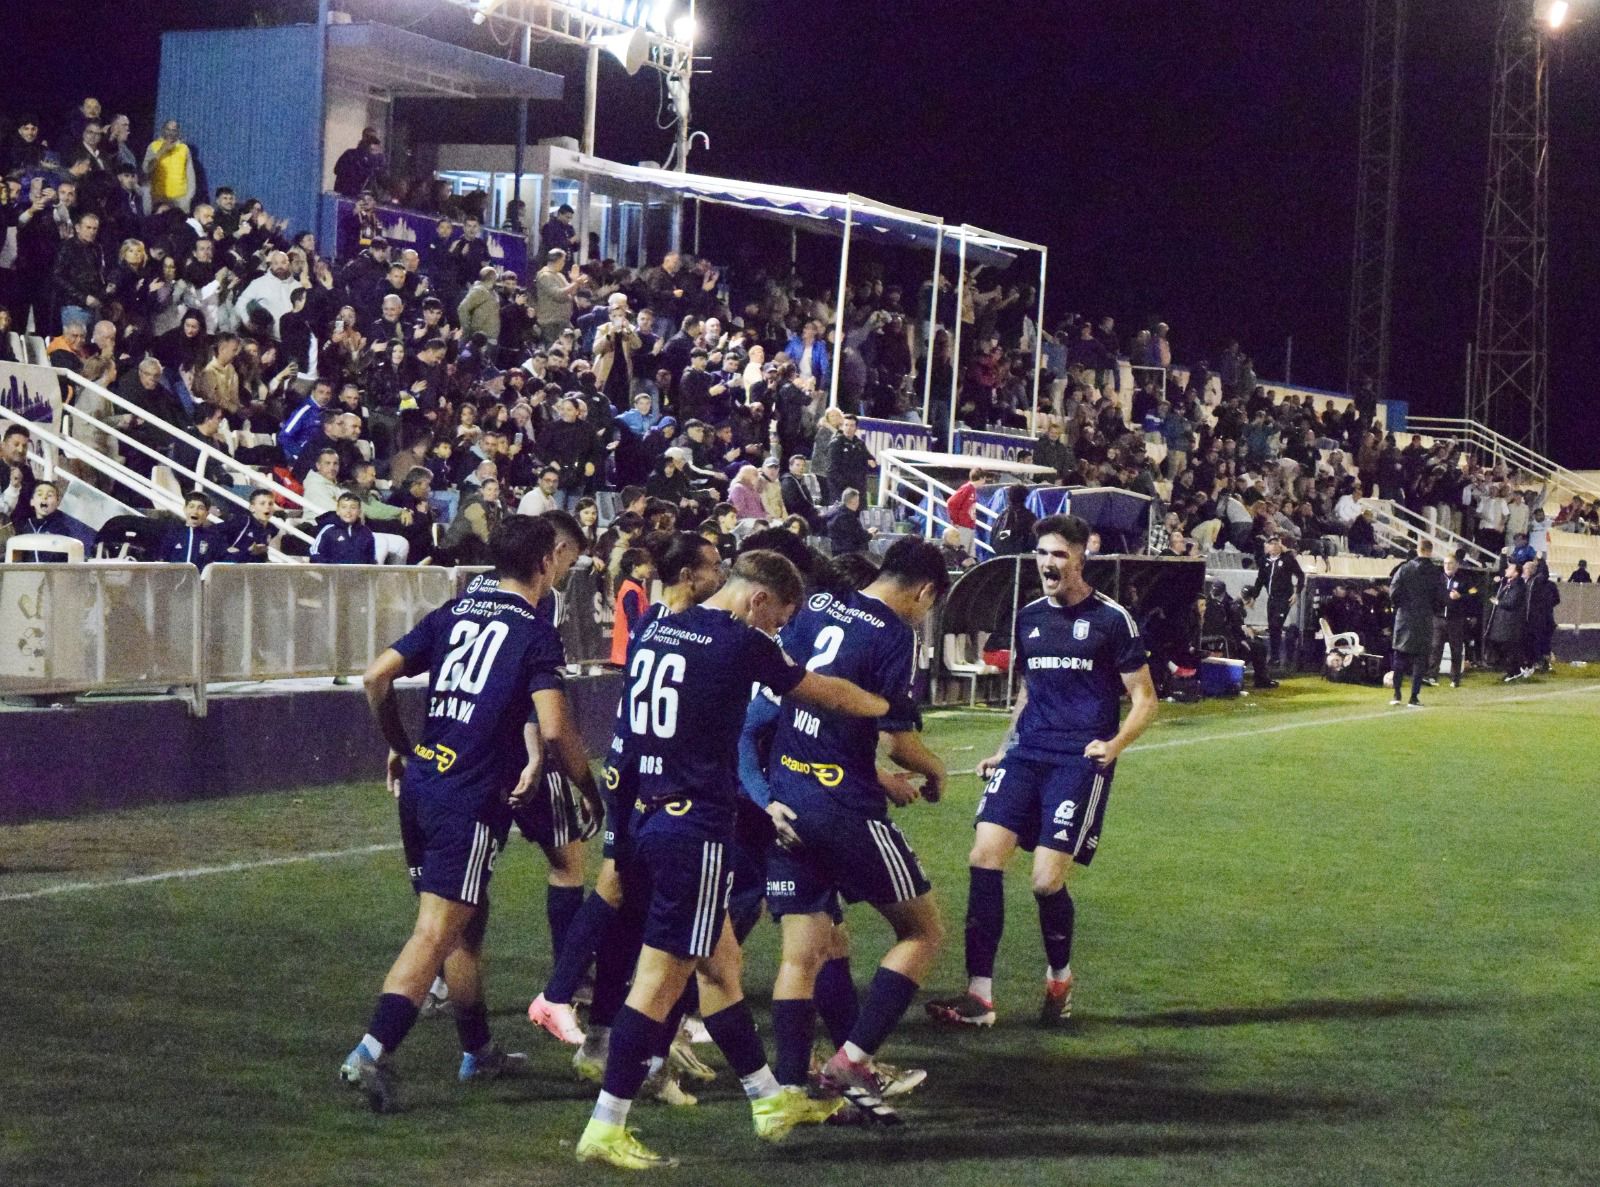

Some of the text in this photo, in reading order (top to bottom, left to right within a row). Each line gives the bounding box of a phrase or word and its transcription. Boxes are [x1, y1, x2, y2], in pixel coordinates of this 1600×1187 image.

[653, 634, 680, 646] HOTELES
[658, 626, 713, 645] SERVIGROUP
[805, 625, 845, 672] 2
[435, 620, 510, 694] 20
[630, 648, 686, 738] 26
[639, 755, 663, 775] ROS
